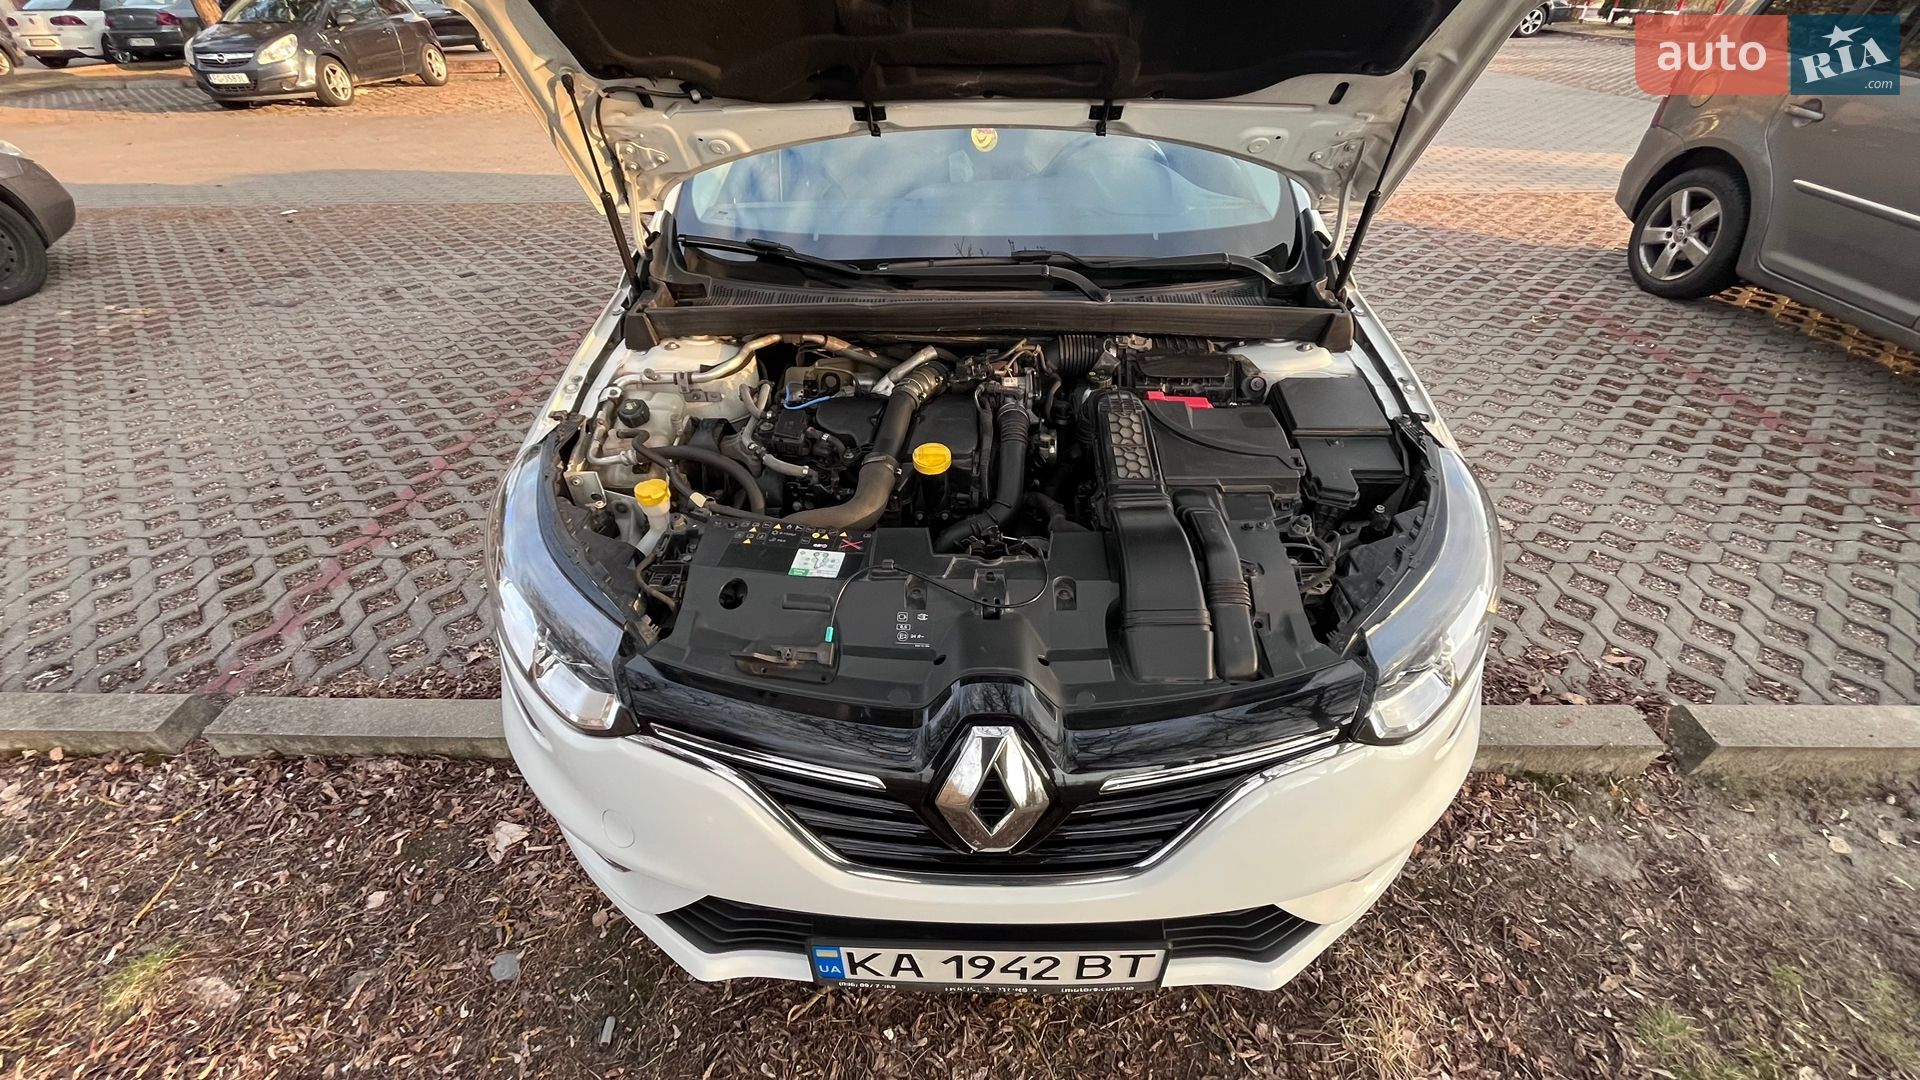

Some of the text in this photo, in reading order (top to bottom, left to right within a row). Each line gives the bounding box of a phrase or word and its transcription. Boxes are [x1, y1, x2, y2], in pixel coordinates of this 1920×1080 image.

[818, 964, 842, 974] UA
[846, 952, 1156, 980] KA 1942 BT
